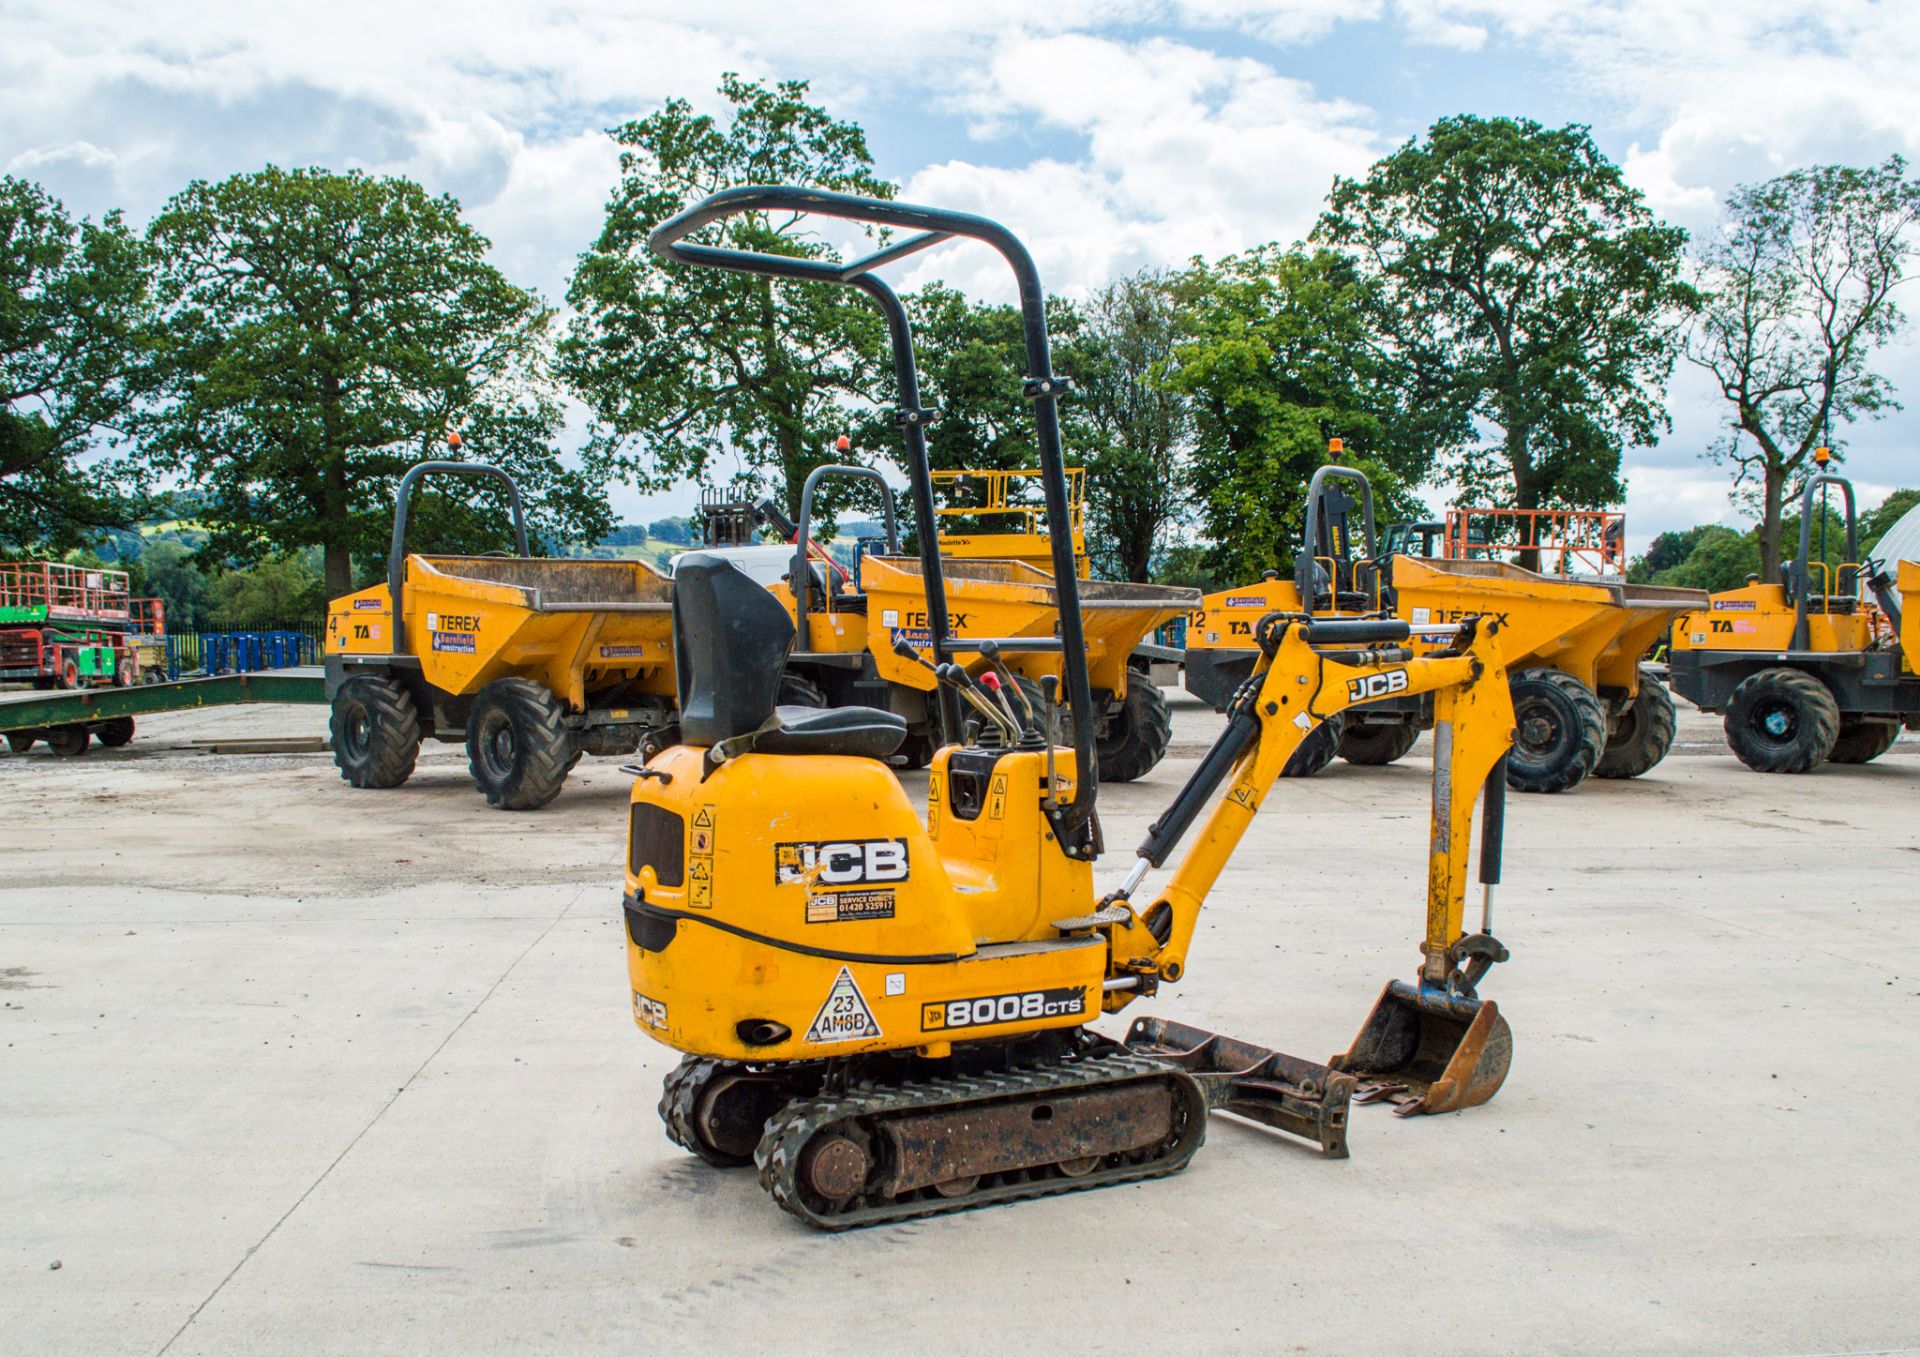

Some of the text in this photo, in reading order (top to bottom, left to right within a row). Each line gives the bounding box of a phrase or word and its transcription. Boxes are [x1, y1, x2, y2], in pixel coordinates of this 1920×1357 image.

[329, 616, 337, 633] 4
[439, 615, 481, 632] TEREX
[1187, 611, 1206, 628] 12
[1680, 615, 1690, 631] 7
[1350, 671, 1408, 701] JCB
[779, 842, 907, 885] JCB
[810, 897, 835, 906] JCB
[839, 901, 893, 912] 01420 525917
[833, 995, 854, 1013] 23
